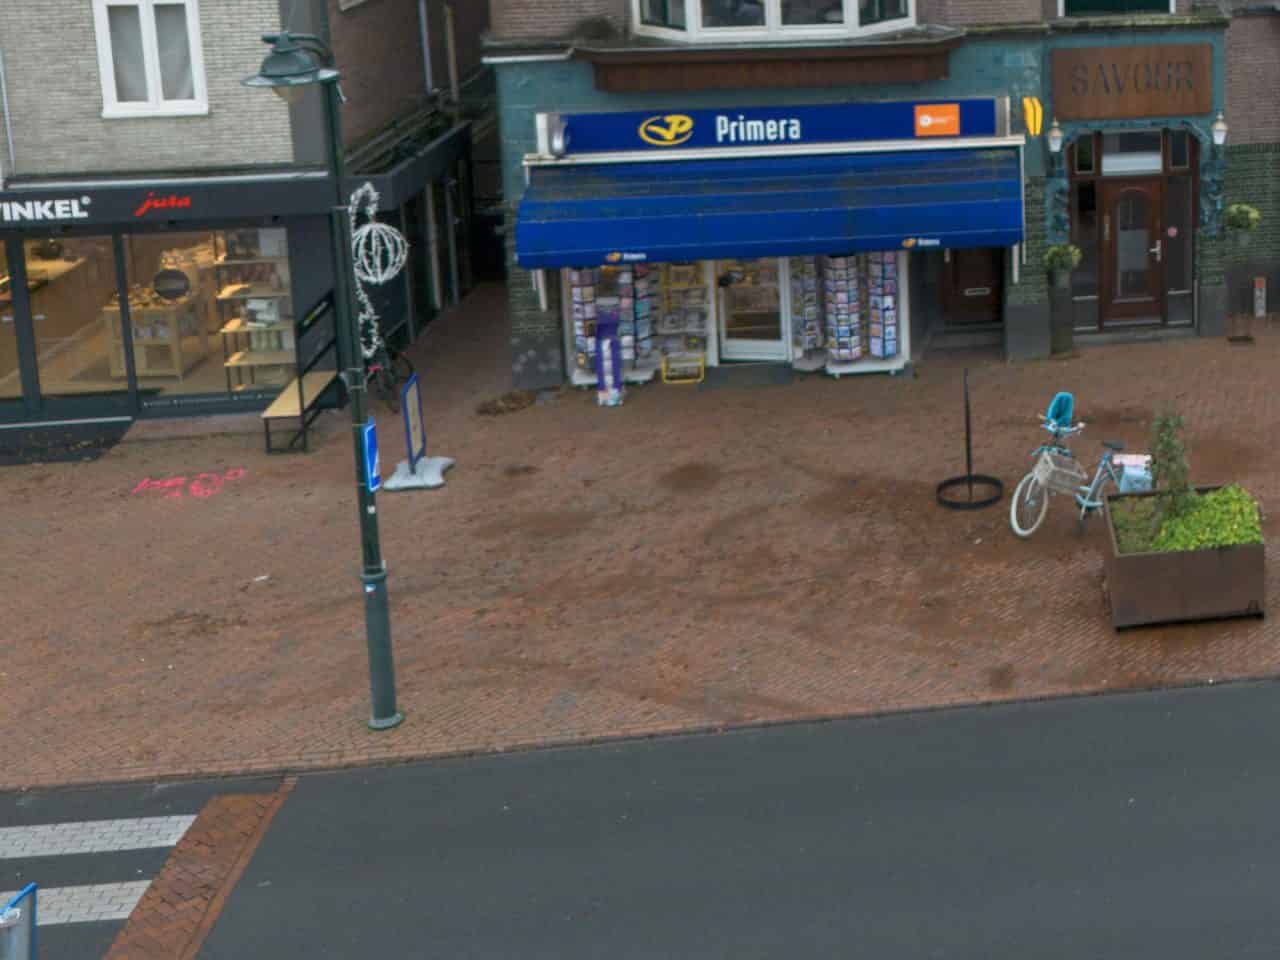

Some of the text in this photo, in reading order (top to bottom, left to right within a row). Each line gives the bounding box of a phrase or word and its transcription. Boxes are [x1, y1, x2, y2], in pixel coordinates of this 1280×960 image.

[1071, 61, 1194, 96] SAVOUR
[715, 115, 801, 143] Primera
[0, 199, 88, 221] INKEL
